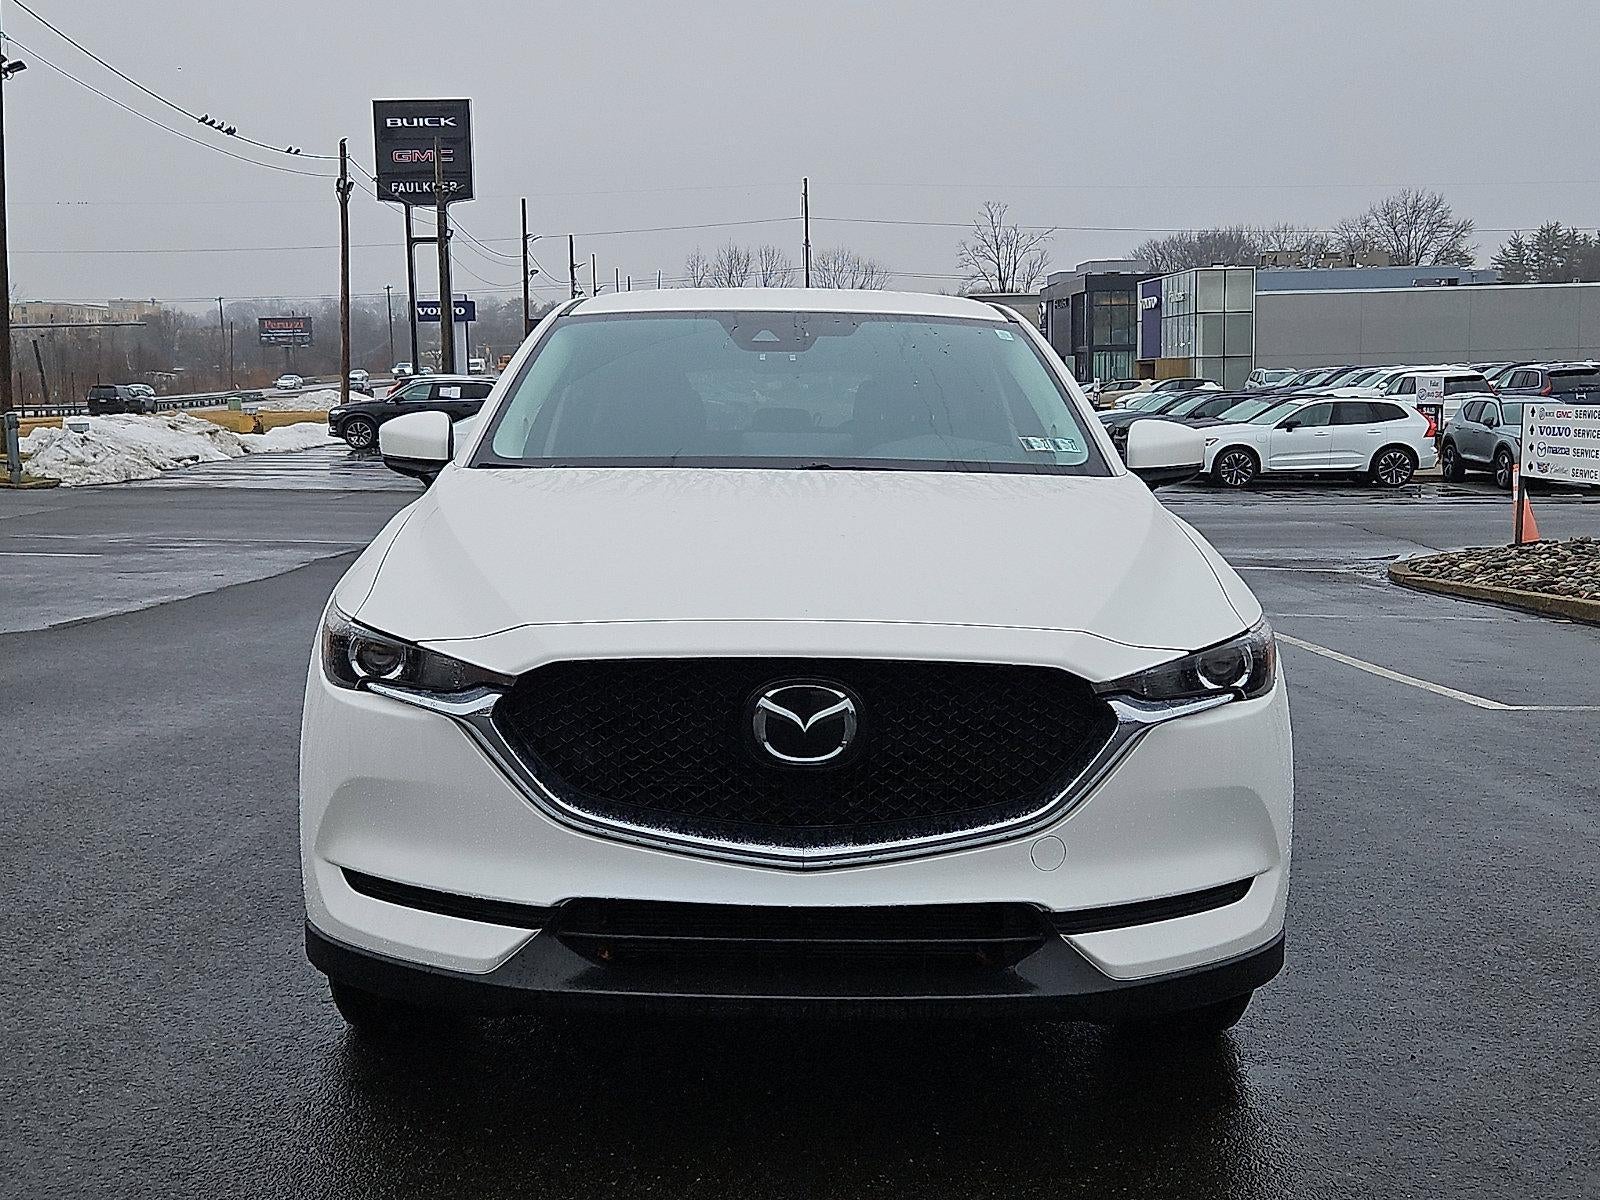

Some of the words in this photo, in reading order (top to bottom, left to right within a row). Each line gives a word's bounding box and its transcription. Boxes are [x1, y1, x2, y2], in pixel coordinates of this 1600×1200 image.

[386, 117, 457, 127] BUICK
[1538, 425, 1571, 437] VOLVO
[1573, 428, 1600, 439] SERVICE
[1572, 447, 1600, 459] SERVICE
[1571, 468, 1599, 480] SERVICE
